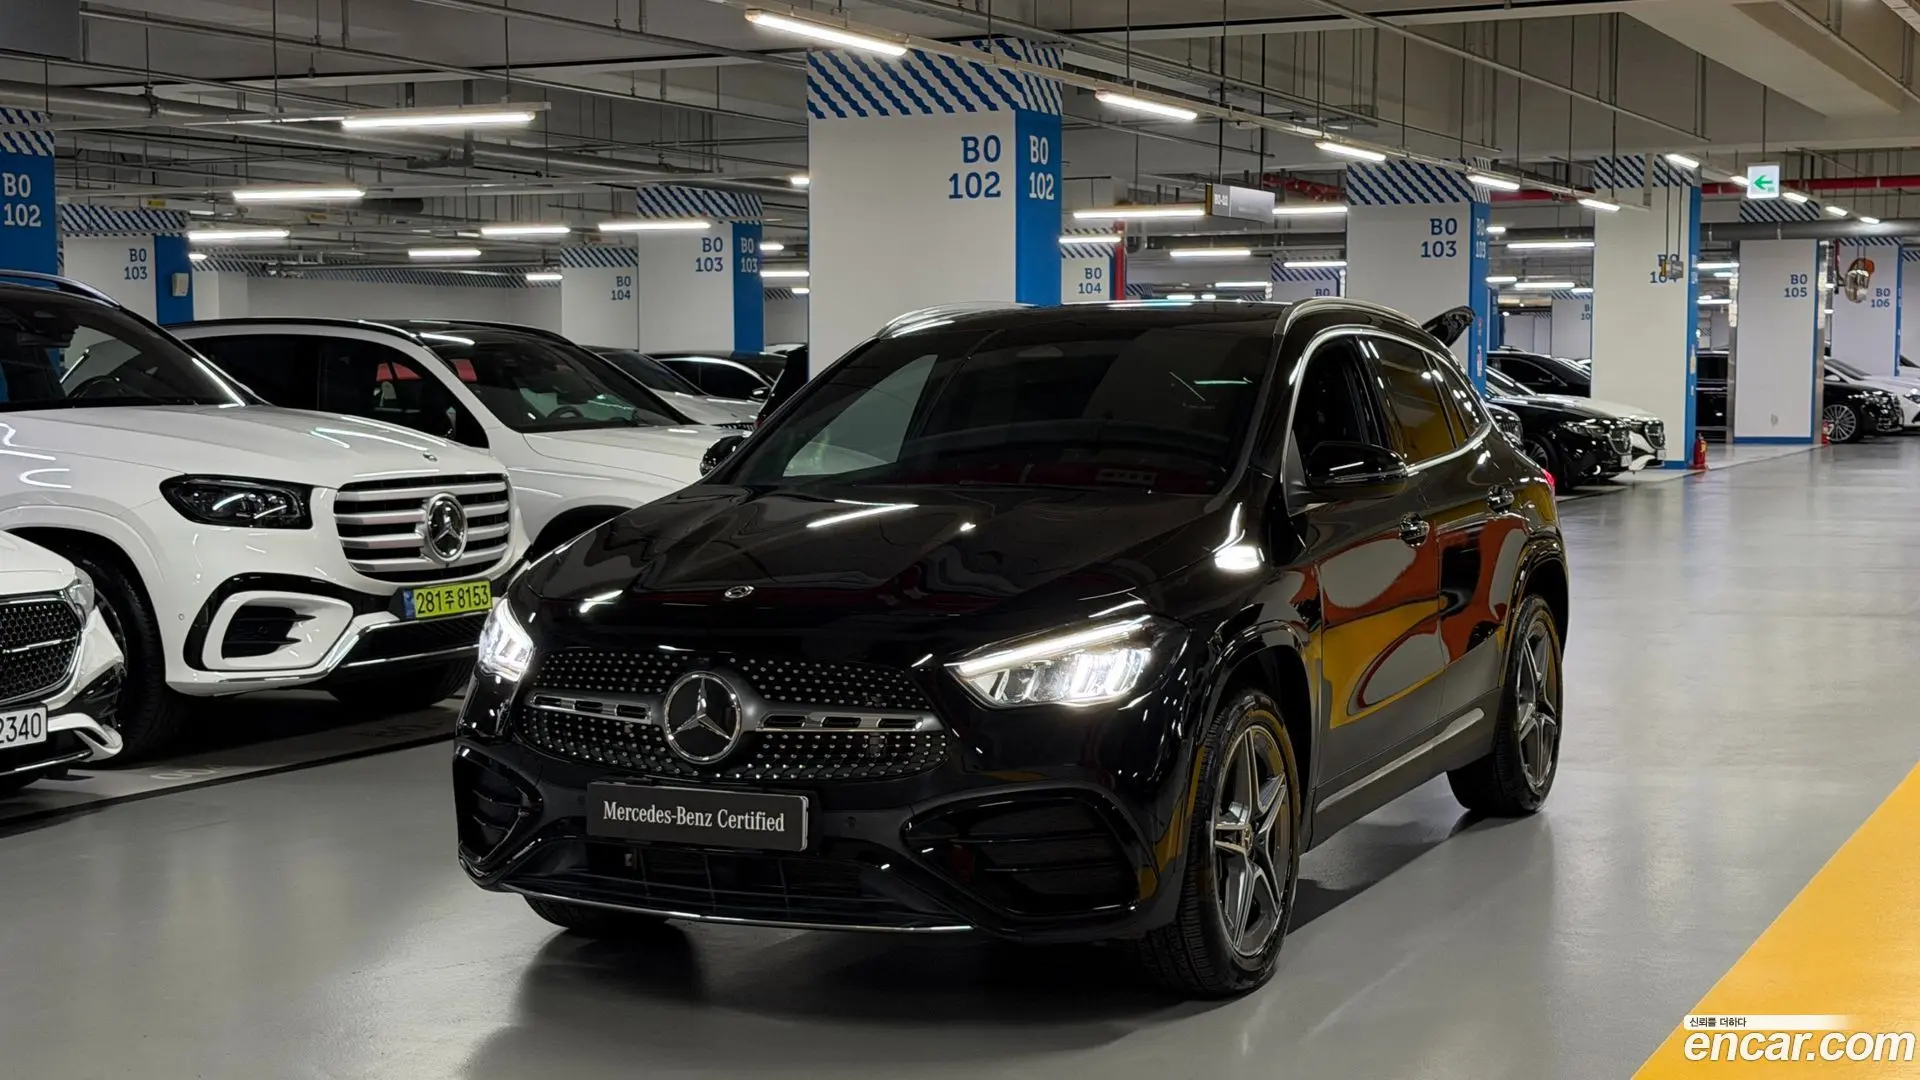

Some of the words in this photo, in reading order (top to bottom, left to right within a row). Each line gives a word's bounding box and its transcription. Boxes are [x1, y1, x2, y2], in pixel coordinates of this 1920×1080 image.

[948, 171, 1001, 199] 102
[1029, 172, 1055, 200] 102
[4, 203, 42, 227] 102
[1421, 240, 1457, 258] 103
[695, 257, 723, 272] 103
[741, 258, 758, 273] 103
[124, 266, 148, 280] 103
[611, 290, 632, 301] 104
[1078, 282, 1102, 294] 104
[1783, 287, 1808, 298] 105
[1871, 299, 1890, 308] 106
[603, 800, 713, 828] Mercedes-Benz
[717, 809, 785, 832] Certified
